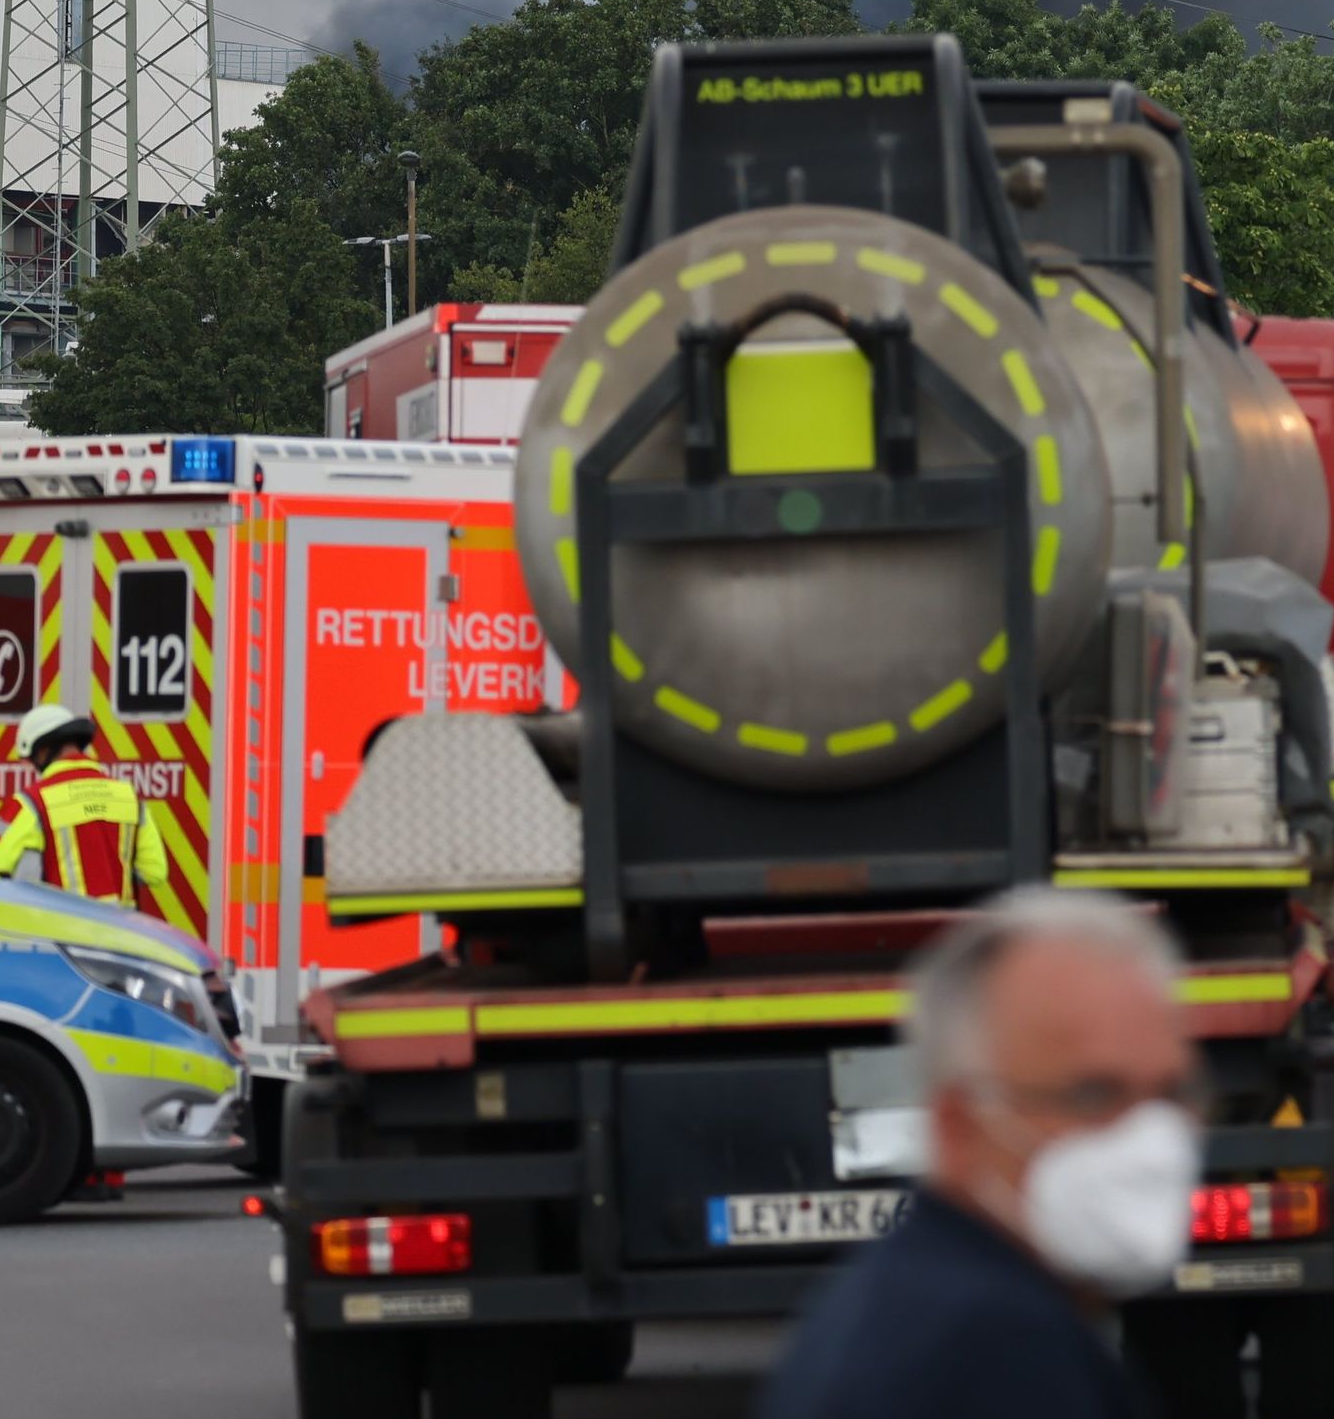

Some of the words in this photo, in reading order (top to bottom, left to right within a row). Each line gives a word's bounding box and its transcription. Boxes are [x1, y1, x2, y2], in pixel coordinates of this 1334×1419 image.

[697, 76, 842, 103] AB-Schaum
[846, 73, 864, 98] 3
[121, 633, 185, 696] 112
[731, 1203, 793, 1235] LEV
[819, 1200, 861, 1232] KR
